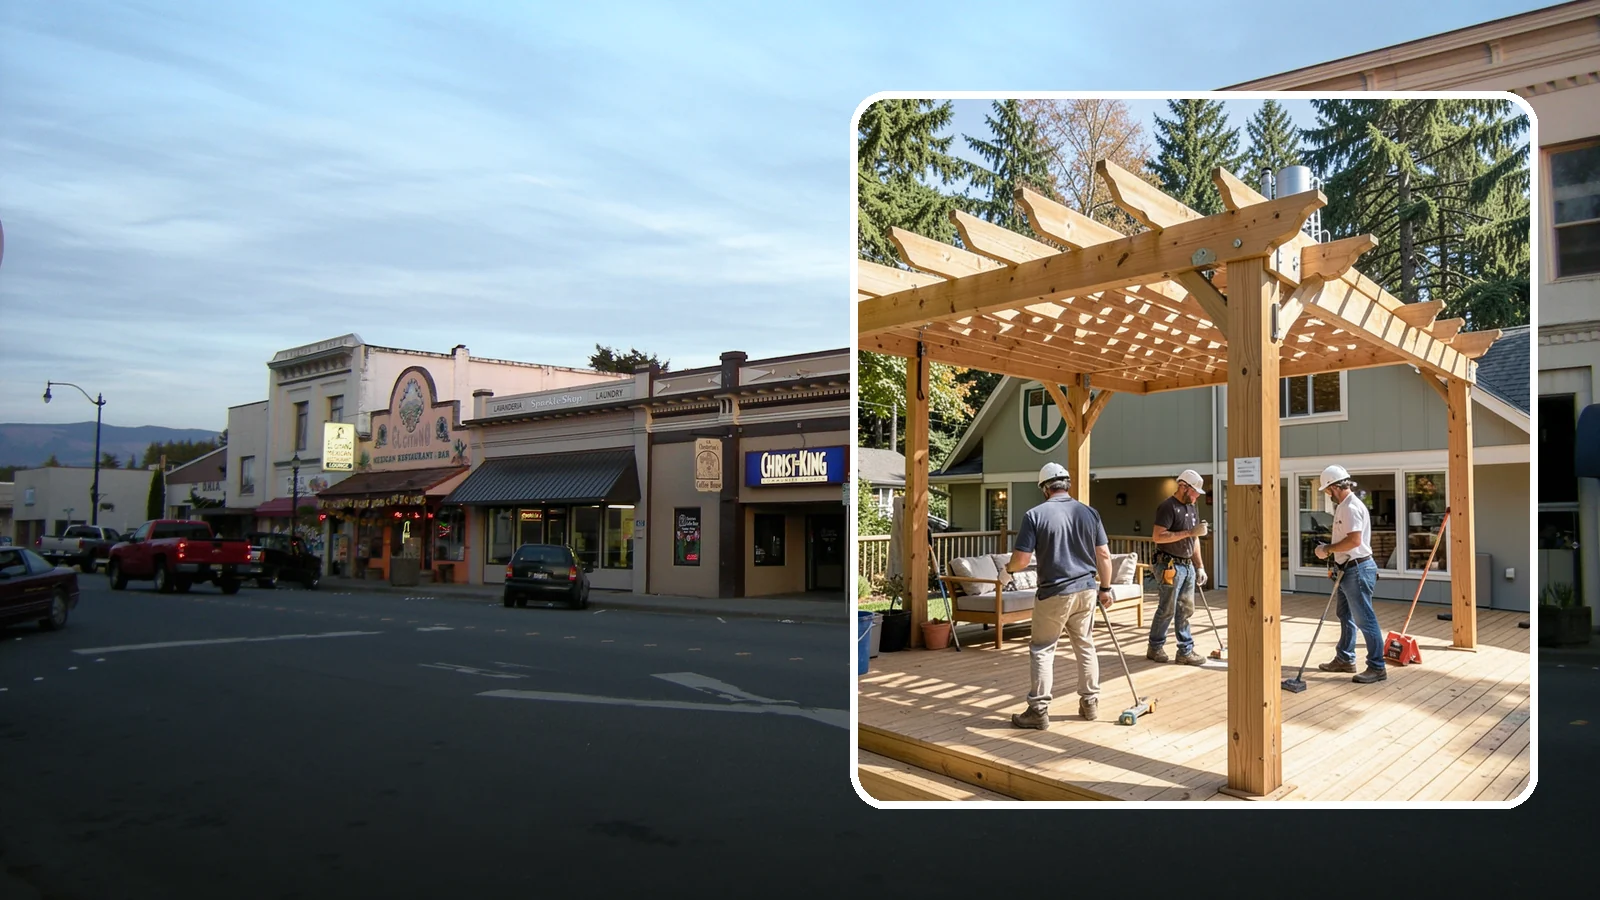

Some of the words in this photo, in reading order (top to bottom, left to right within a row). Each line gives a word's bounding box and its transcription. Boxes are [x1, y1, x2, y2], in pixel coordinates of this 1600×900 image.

[493, 402, 522, 413] LAVANDERIA
[531, 397, 561, 409] Sparkle
[562, 394, 582, 405] Shop
[595, 388, 623, 400] LAUNDRY
[373, 454, 396, 464] MEXICAN
[397, 451, 433, 462] RESTAURANT
[438, 450, 450, 459] BAR
[760, 451, 797, 478] CHRIST
[799, 449, 827, 477] KING
